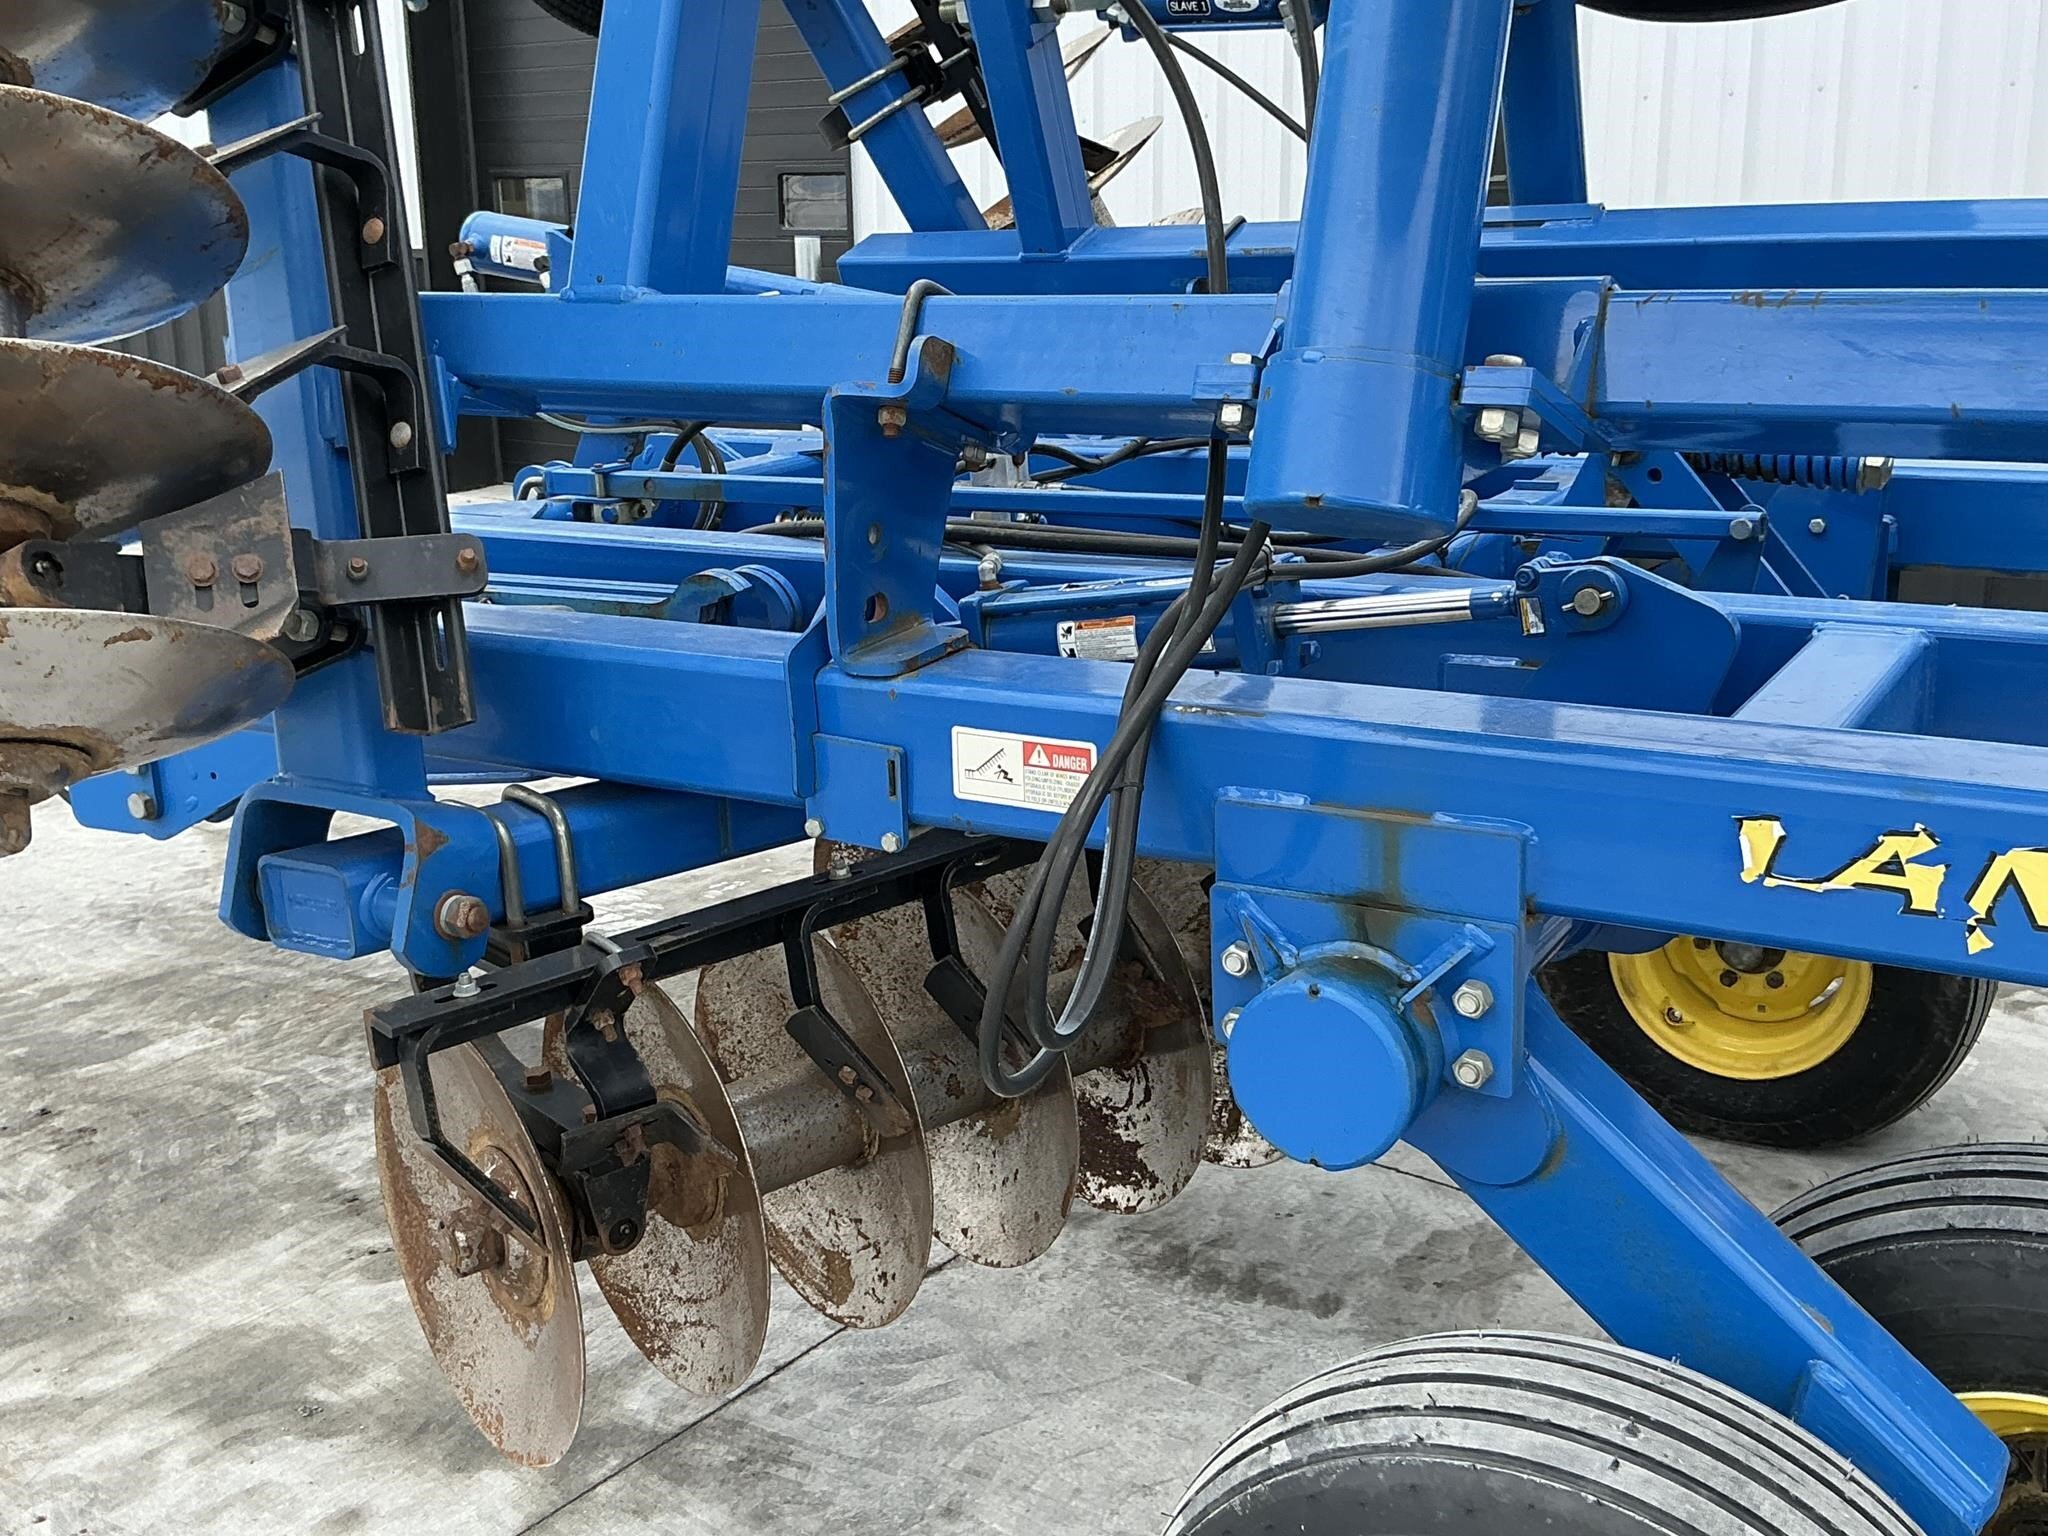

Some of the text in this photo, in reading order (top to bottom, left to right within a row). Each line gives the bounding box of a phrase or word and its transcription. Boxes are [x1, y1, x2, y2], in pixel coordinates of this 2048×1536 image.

[1170, 1, 1207, 11] SLAVE 1
[1052, 754, 1087, 771] DANGER
